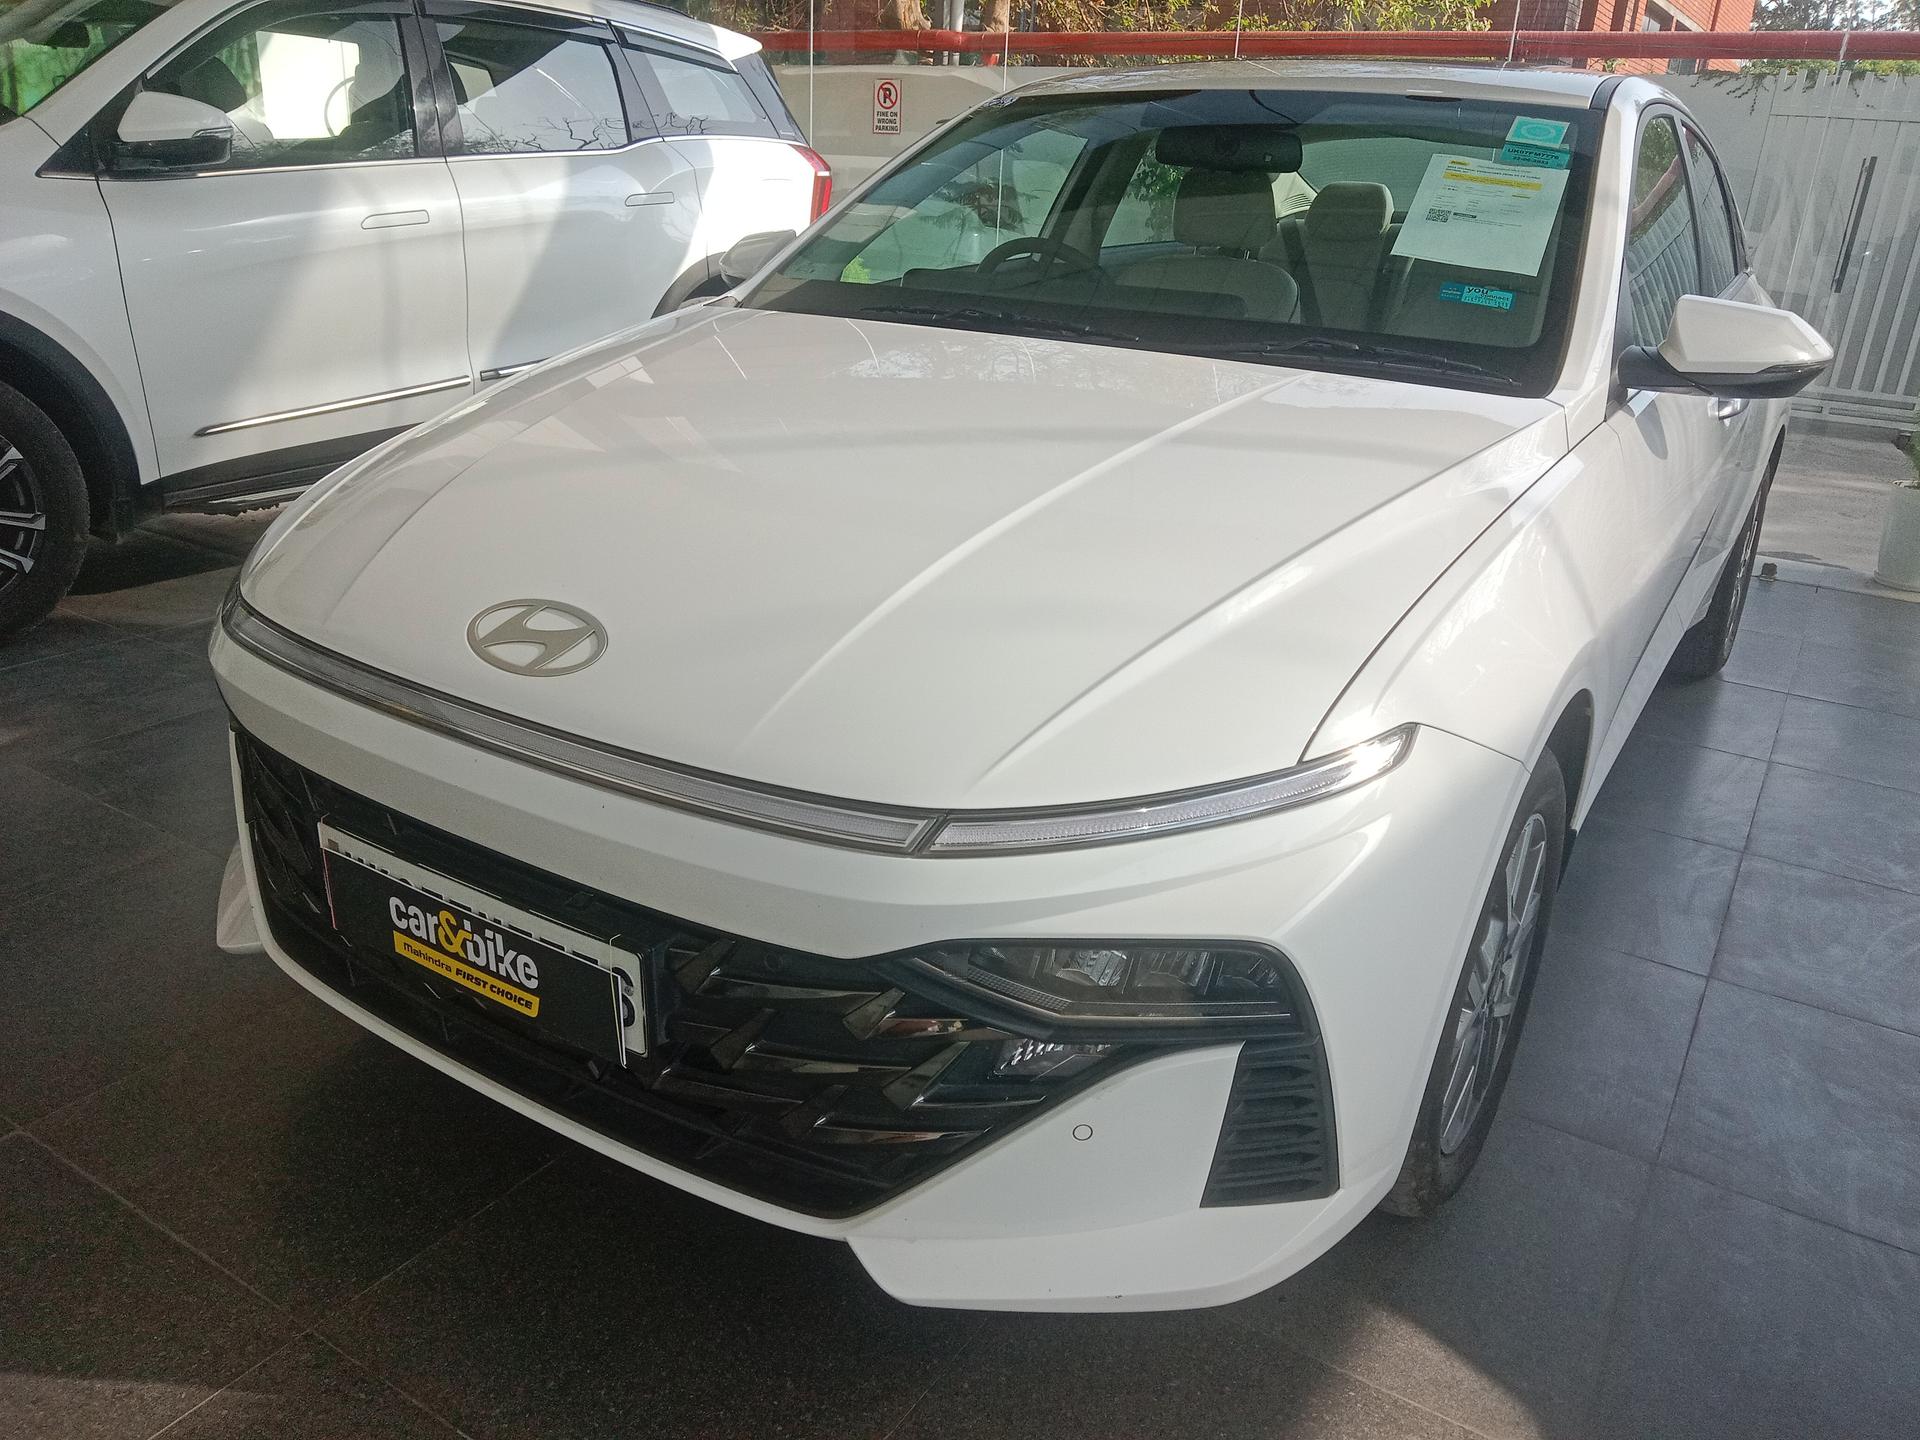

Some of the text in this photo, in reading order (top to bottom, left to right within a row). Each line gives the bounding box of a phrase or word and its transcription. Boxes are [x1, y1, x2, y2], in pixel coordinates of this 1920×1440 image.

[1467, 287, 1489, 295] you
[389, 896, 539, 989] car&bike
[403, 942, 533, 1010] Mahindra FIRST CHOICE
